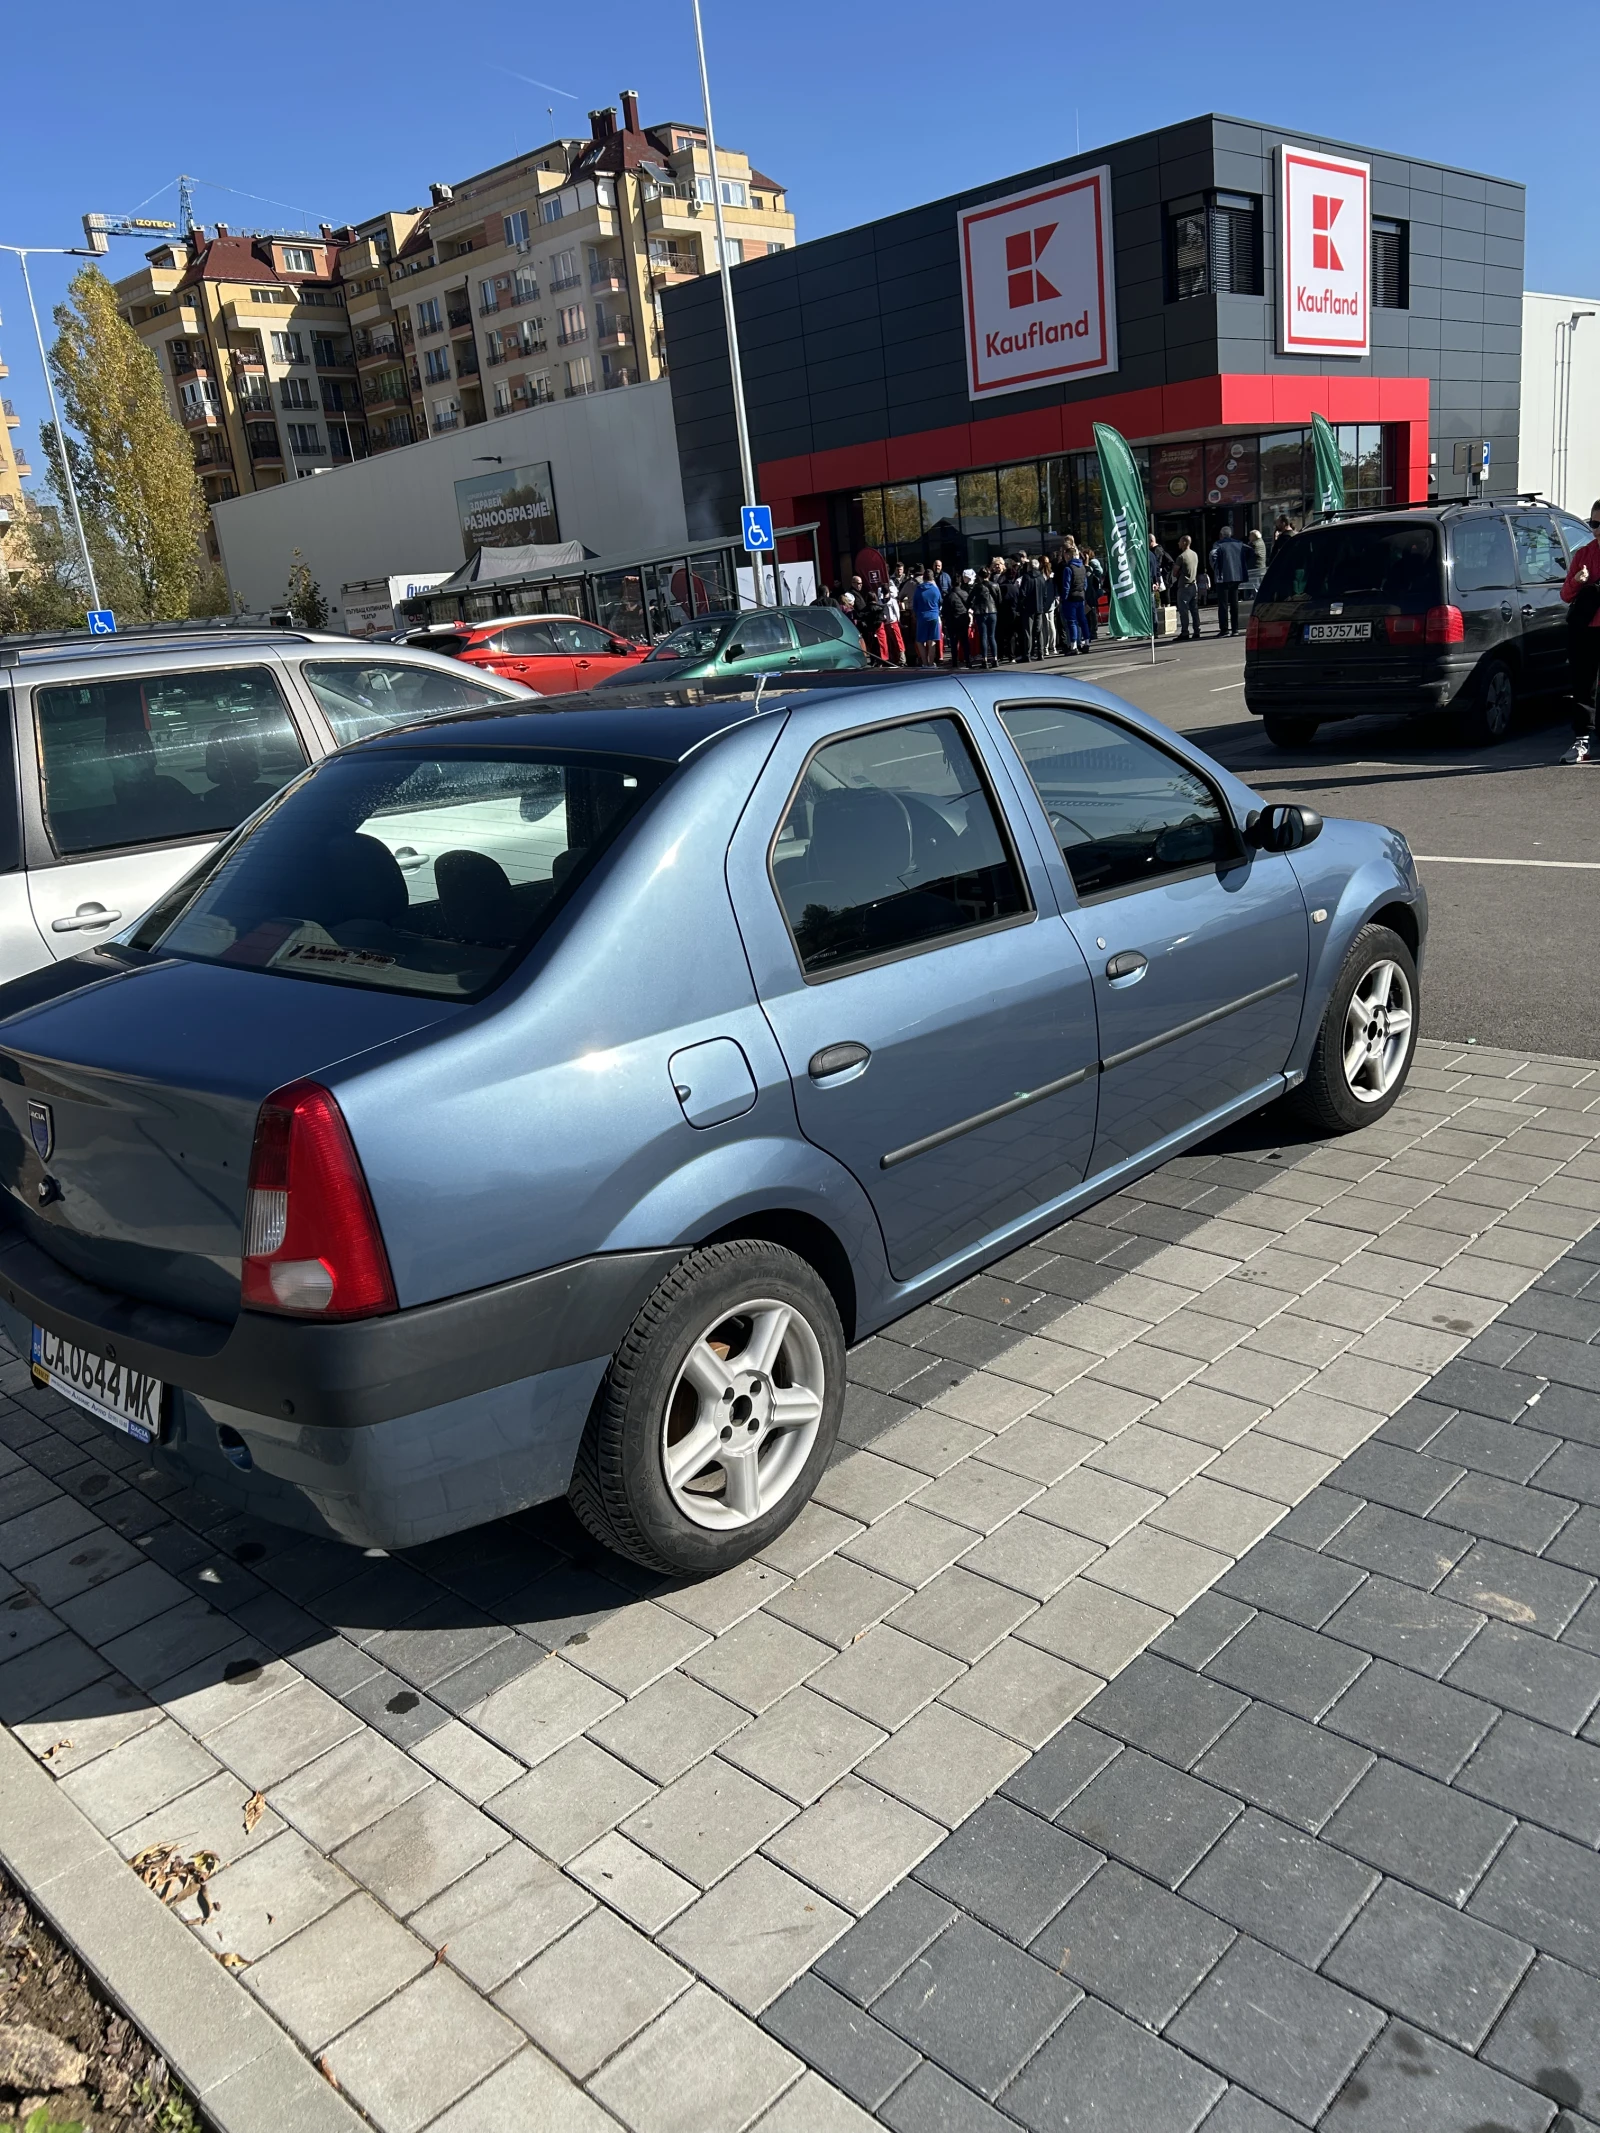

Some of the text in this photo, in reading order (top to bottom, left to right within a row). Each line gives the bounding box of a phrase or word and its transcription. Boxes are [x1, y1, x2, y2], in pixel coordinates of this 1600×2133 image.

[135, 218, 177, 229] IZOTECH
[1297, 285, 1358, 316] Kaufland
[985, 310, 1089, 358] Kaufland
[463, 498, 551, 531] РАЗНООБРАЗИЕ!
[469, 495, 504, 512] ЗДРАВЕЙ,
[1310, 624, 1370, 639] CB 3757 ME
[124, 1367, 155, 1427] MK
[130, 1424, 149, 1438] DACIA
